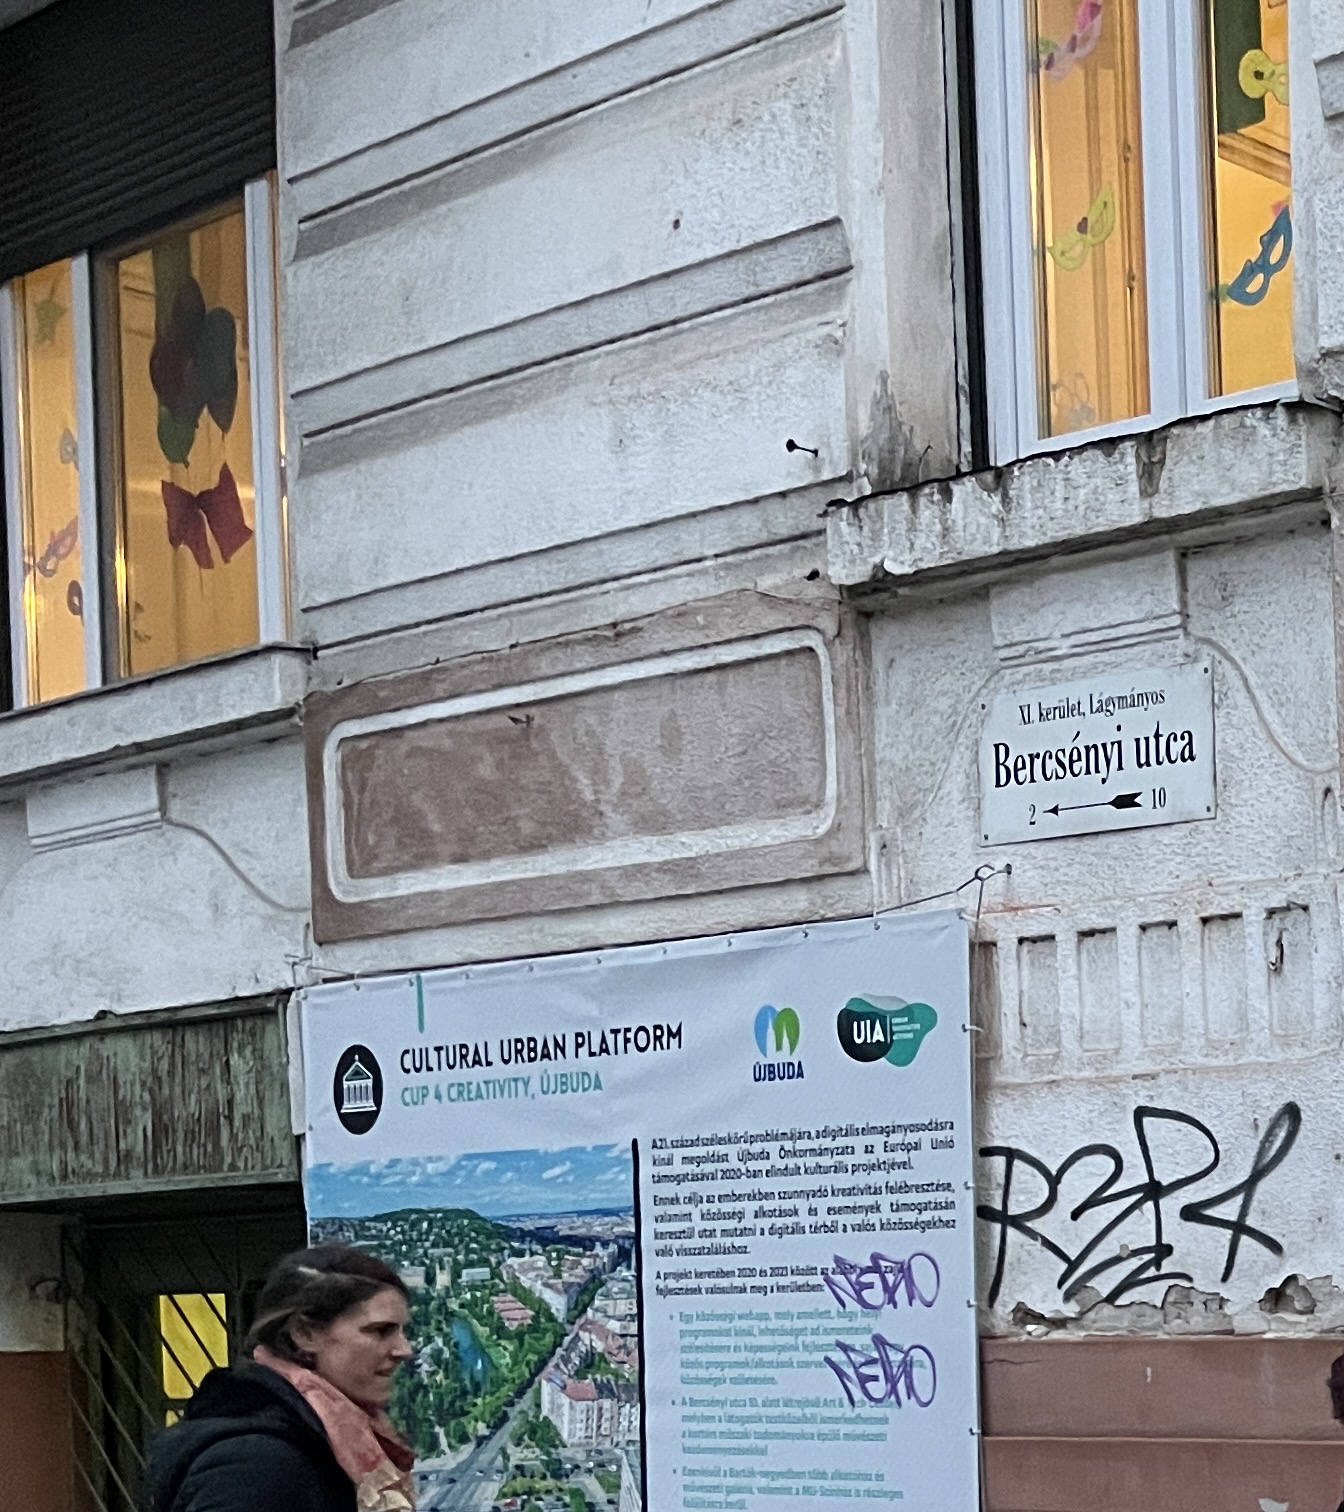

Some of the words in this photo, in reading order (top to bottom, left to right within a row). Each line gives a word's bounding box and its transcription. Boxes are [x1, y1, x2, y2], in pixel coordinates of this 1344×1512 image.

[1019, 704, 1034, 725] XI.
[1038, 697, 1086, 723] kerület,
[1089, 687, 1165, 717] Lágymányos
[993, 724, 1124, 788] Bercsényi
[1134, 721, 1196, 769] utca
[1029, 804, 1037, 825] 2
[1151, 787, 1167, 809] 10
[400, 1041, 493, 1074] CULTURAL
[500, 1034, 566, 1064] URBAN
[574, 1022, 683, 1058] PLATFORM
[853, 1019, 885, 1044] UIA
[401, 1086, 429, 1107] CUP
[448, 1076, 535, 1103] CREATIVITY,
[540, 1069, 603, 1095] ÚJBUDA
